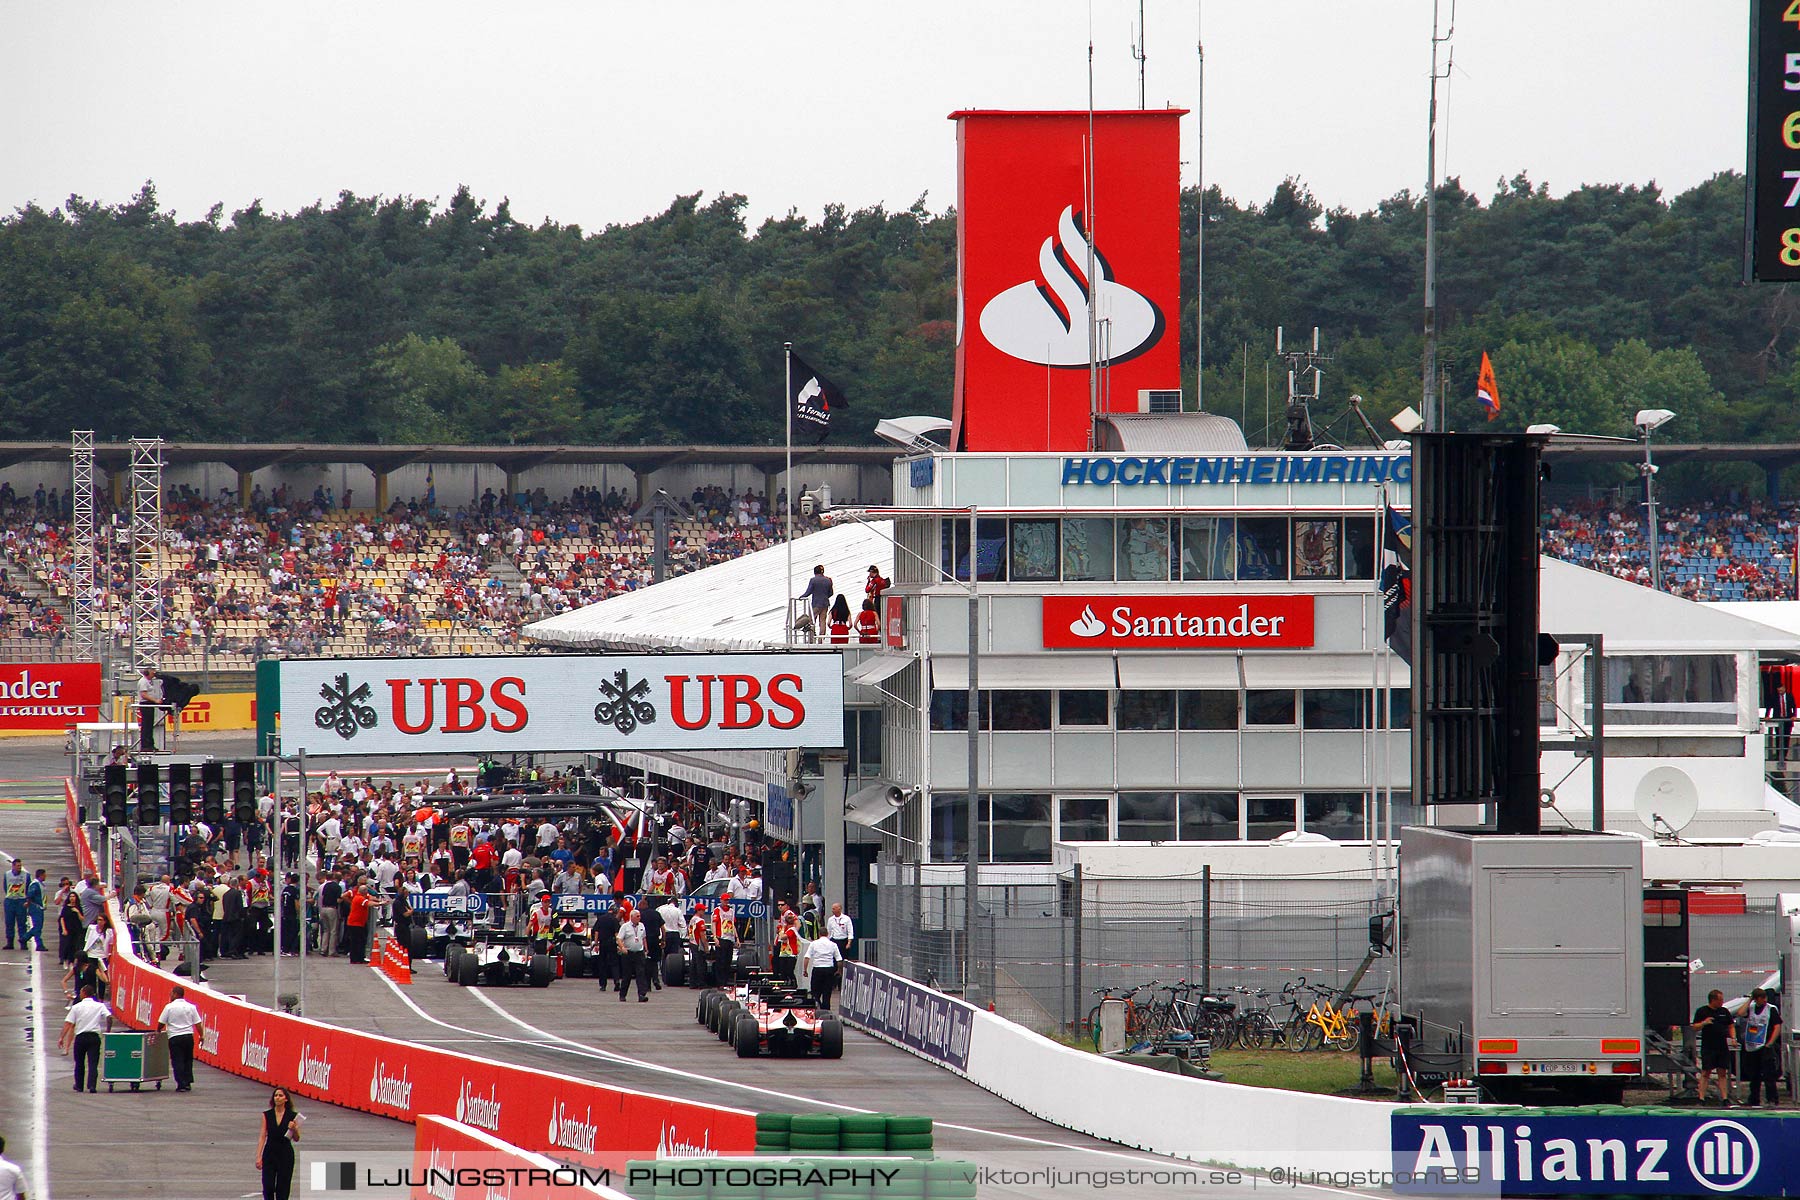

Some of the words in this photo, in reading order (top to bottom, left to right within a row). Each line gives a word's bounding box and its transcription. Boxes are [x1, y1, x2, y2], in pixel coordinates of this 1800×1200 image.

[1783, 53, 1800, 91] 5
[1782, 110, 1800, 149] 6
[1782, 170, 1800, 208] 7
[1061, 456, 1410, 487] HOCKENHEIMRING
[1111, 603, 1285, 638] Santander
[386, 676, 528, 733] UBS
[663, 673, 804, 729] UBS
[304, 1043, 332, 1091] Santander
[377, 1062, 413, 1111] Santander
[464, 1080, 502, 1132] Santander
[557, 1101, 598, 1155] Santander
[1412, 1125, 1670, 1182] Allianz
